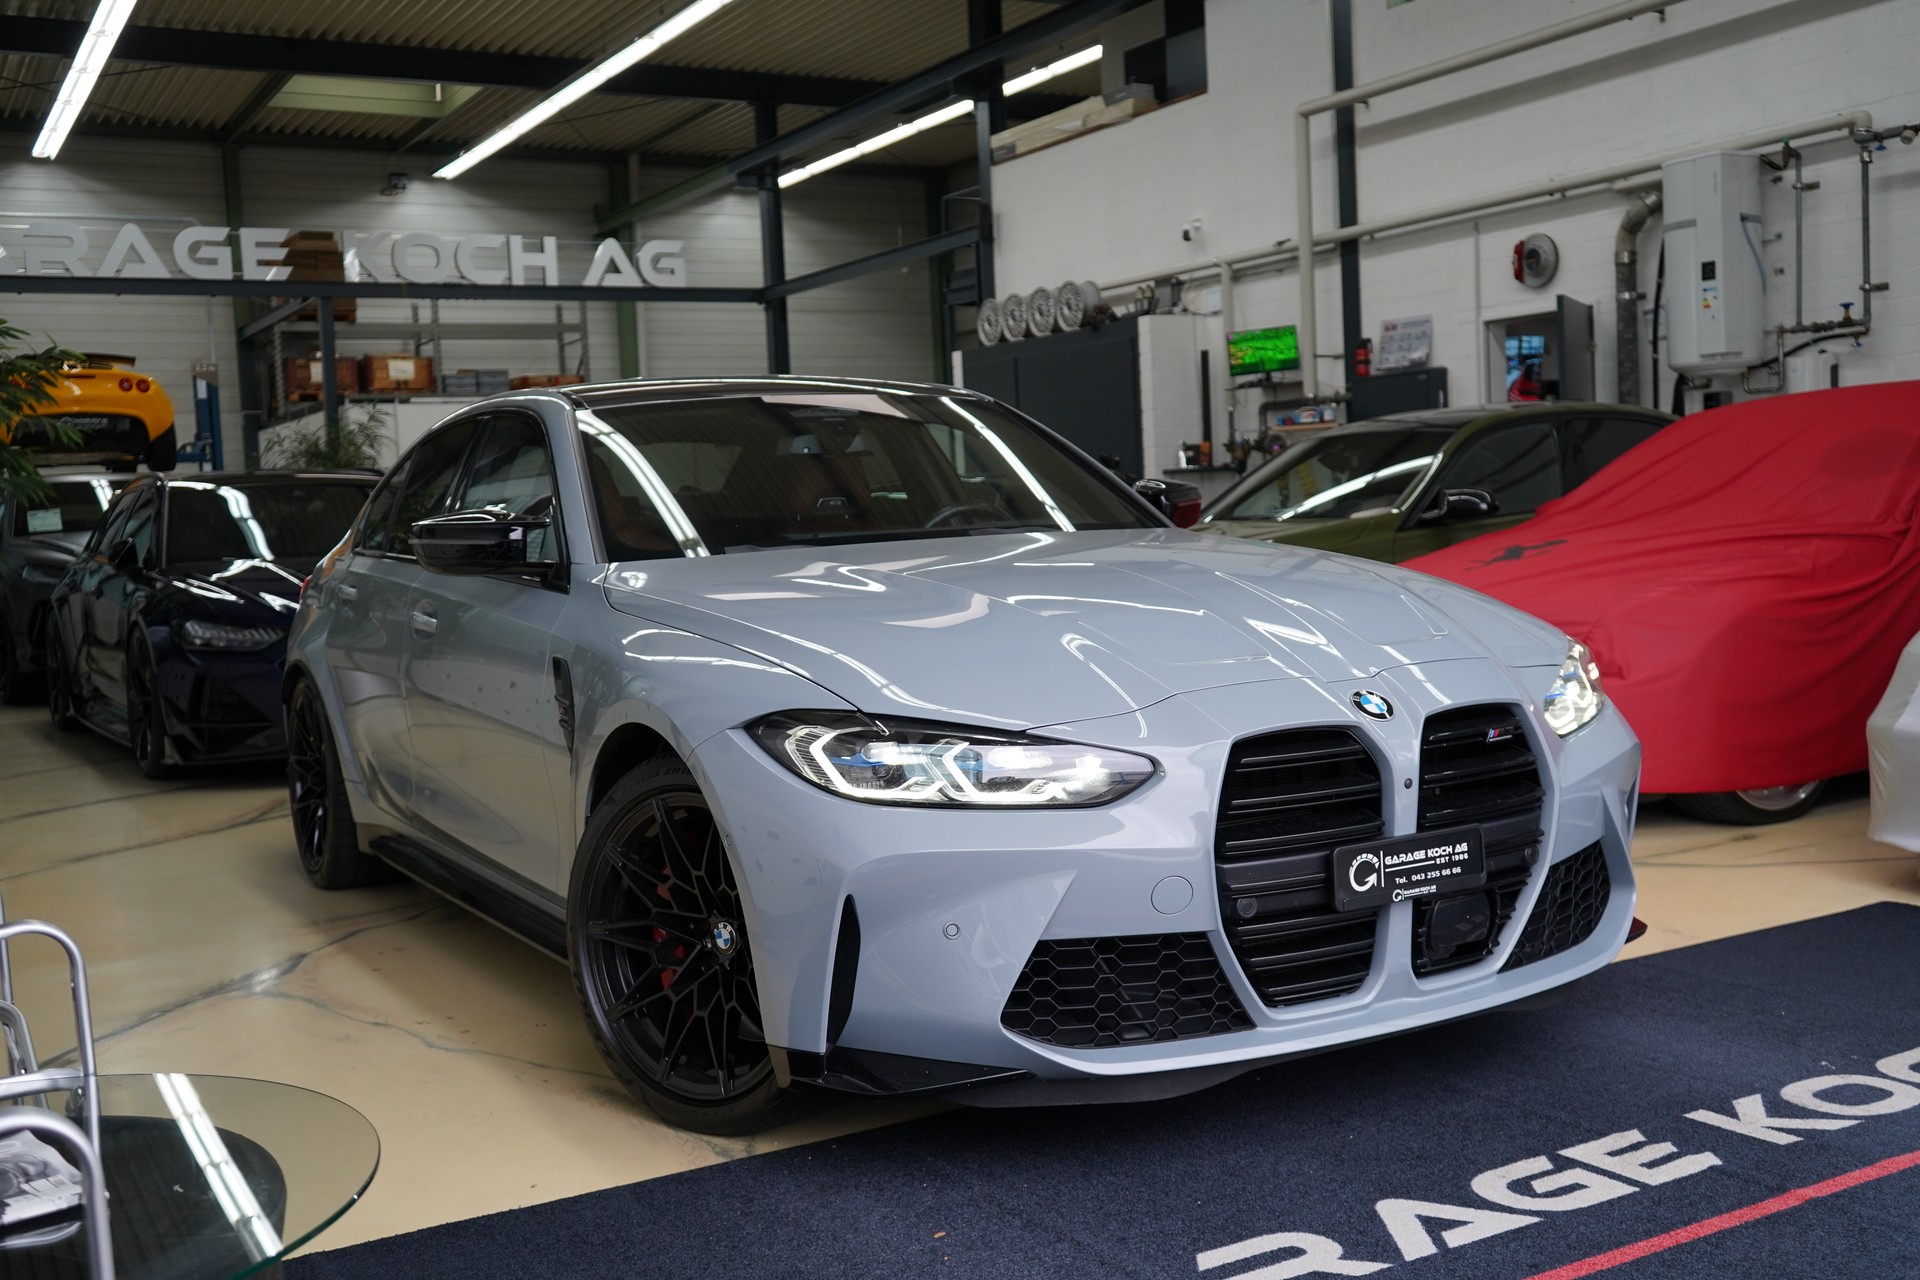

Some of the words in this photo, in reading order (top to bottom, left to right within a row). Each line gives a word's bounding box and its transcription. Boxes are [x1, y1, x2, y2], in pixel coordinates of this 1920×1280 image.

[343, 230, 559, 285] KOCH
[582, 237, 686, 287] AG
[1385, 850, 1426, 865] GARAGE
[1427, 844, 1453, 858] KOCH
[1454, 842, 1468, 853] AG
[1436, 856, 1450, 865] EST
[1452, 853, 1469, 862] 1986
[1395, 876, 1408, 884] Tel.
[1411, 873, 1425, 881] 043
[1427, 871, 1440, 879] 255
